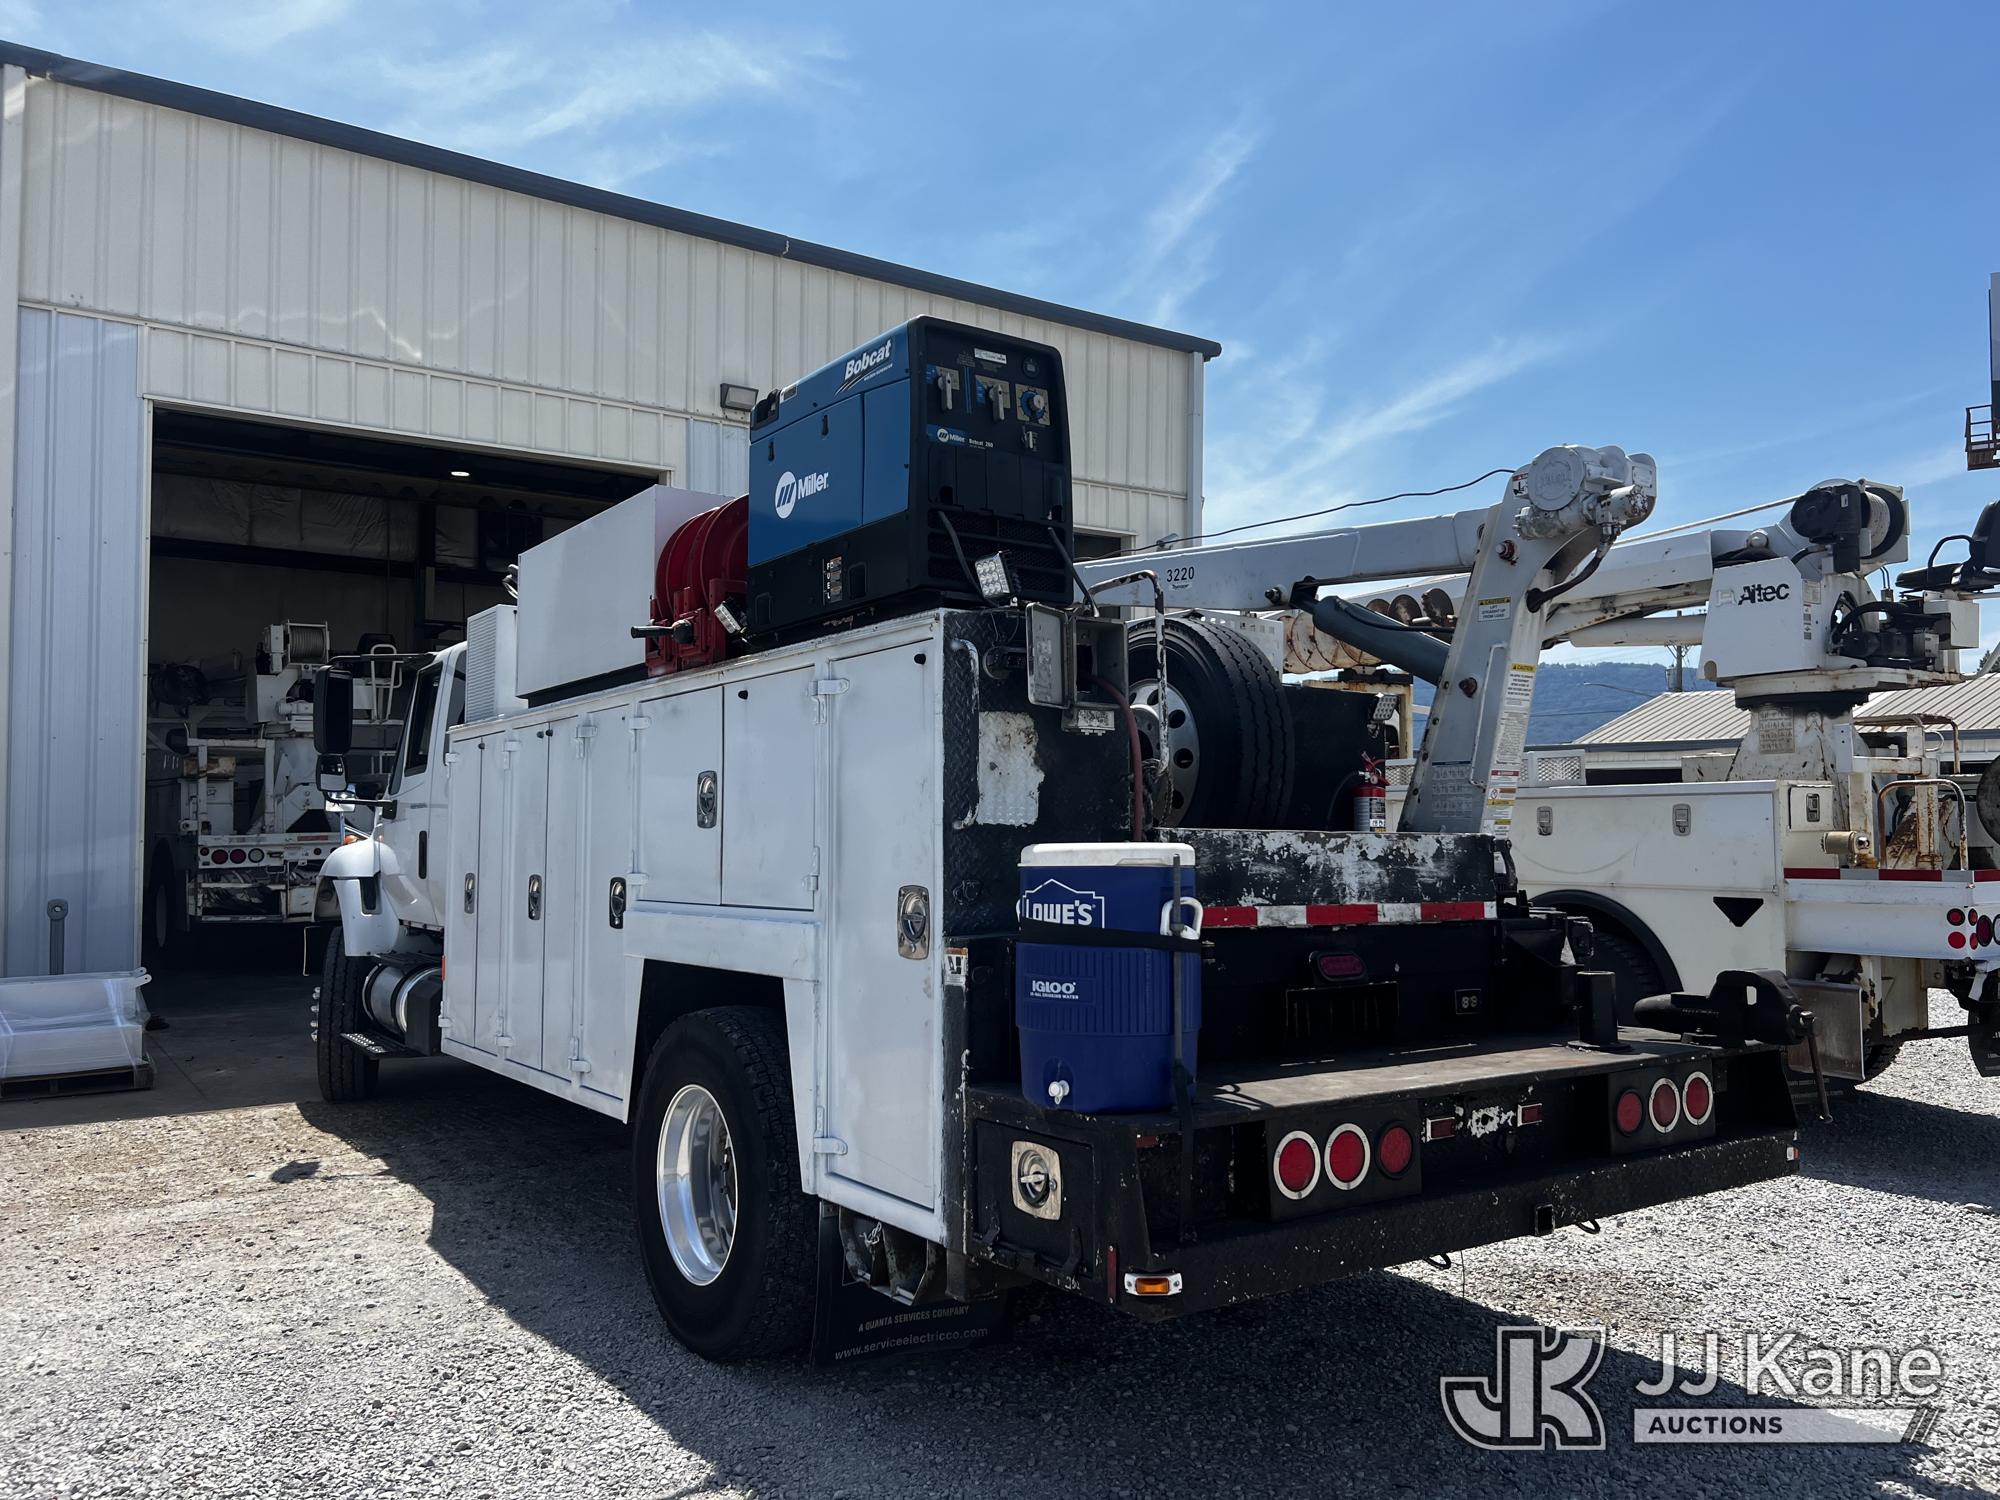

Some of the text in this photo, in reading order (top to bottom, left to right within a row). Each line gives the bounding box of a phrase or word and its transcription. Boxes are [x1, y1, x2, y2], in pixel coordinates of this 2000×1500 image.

[845, 339, 892, 380] Bobcat
[949, 433, 965, 443] Miller
[798, 472, 829, 501] Miller
[1166, 566, 1195, 582] 3220
[1738, 583, 1790, 606] Altec
[1026, 899, 1092, 926] LOWE'S
[1032, 980, 1075, 995] IGLOO
[858, 1305, 970, 1333] A QUANTA SERVICES COMPANY
[834, 1327, 989, 1361] www.serviceelectricco.com
